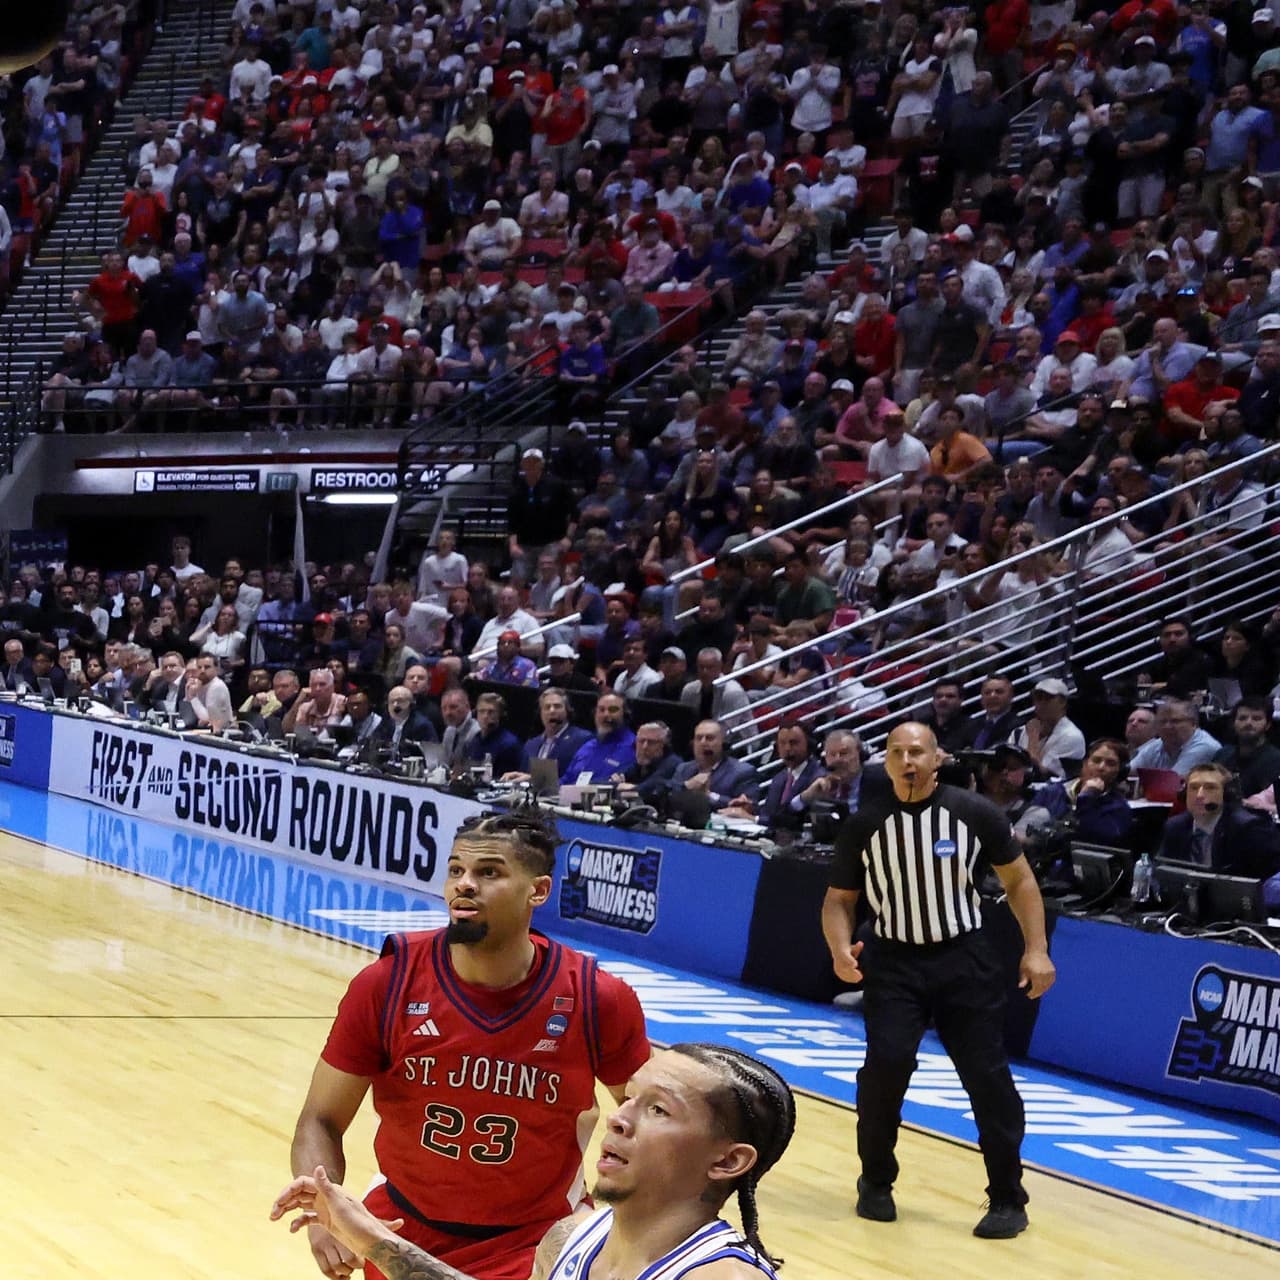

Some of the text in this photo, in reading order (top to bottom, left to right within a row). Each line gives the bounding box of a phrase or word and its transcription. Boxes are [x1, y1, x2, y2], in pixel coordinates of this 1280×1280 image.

[157, 473, 196, 481] ELEVATOR
[90, 730, 439, 882] FIRST AND SECOND ROUNDS
[581, 848, 634, 885] MARCH
[587, 880, 657, 923] MADNESS
[404, 1055, 561, 1104] ST. JOHN'S
[420, 1102, 519, 1165] 23
